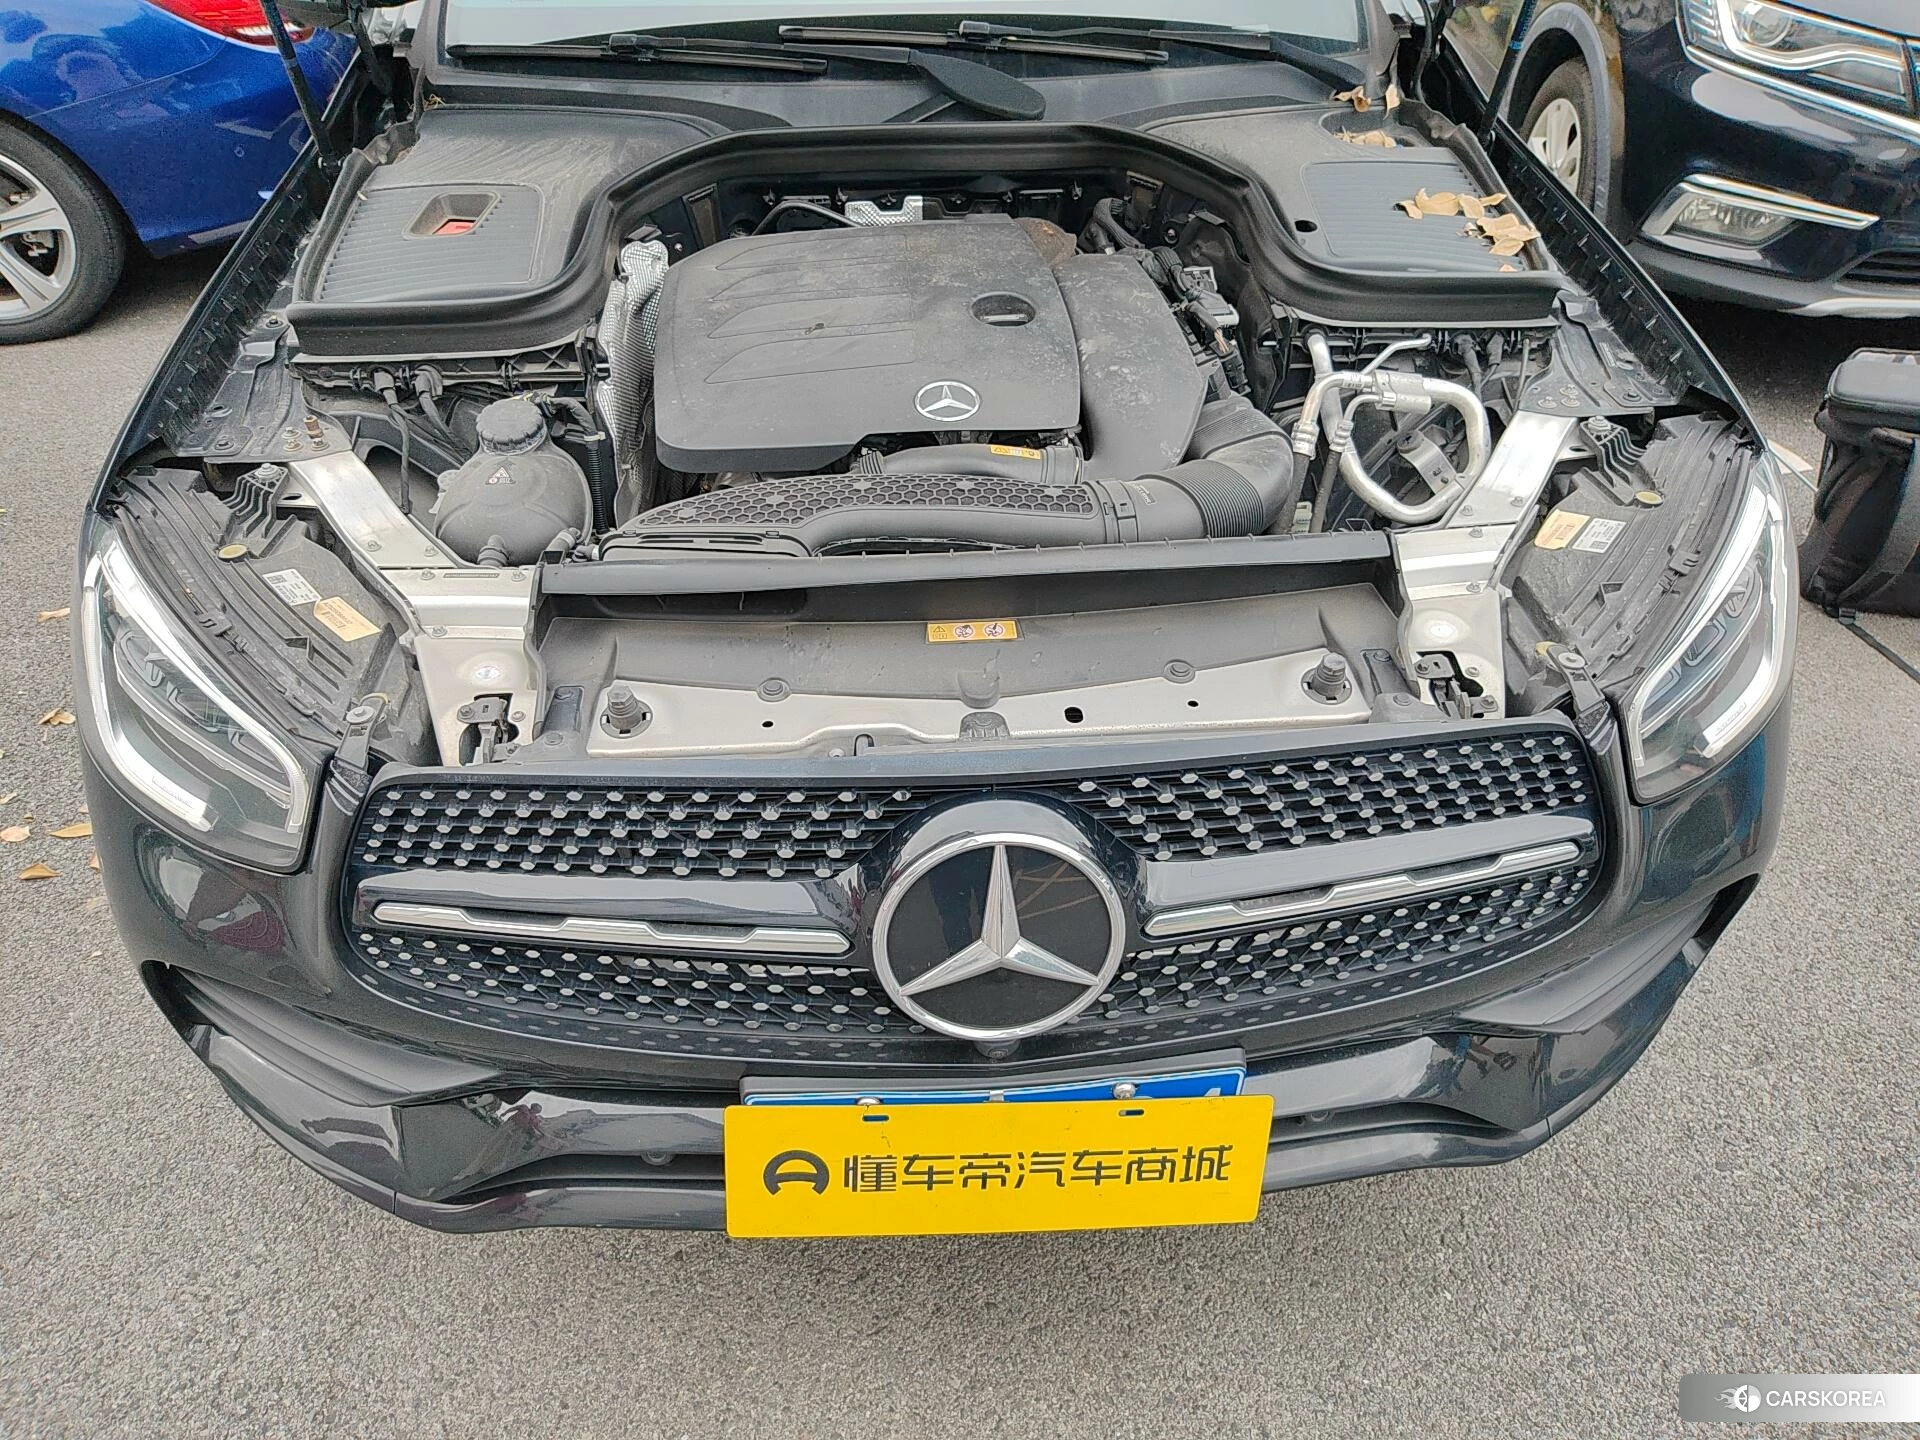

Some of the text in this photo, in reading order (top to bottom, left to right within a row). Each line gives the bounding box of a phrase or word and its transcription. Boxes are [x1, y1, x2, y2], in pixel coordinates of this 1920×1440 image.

[843, 1145, 1233, 1192] 懂车帝汽车商城
